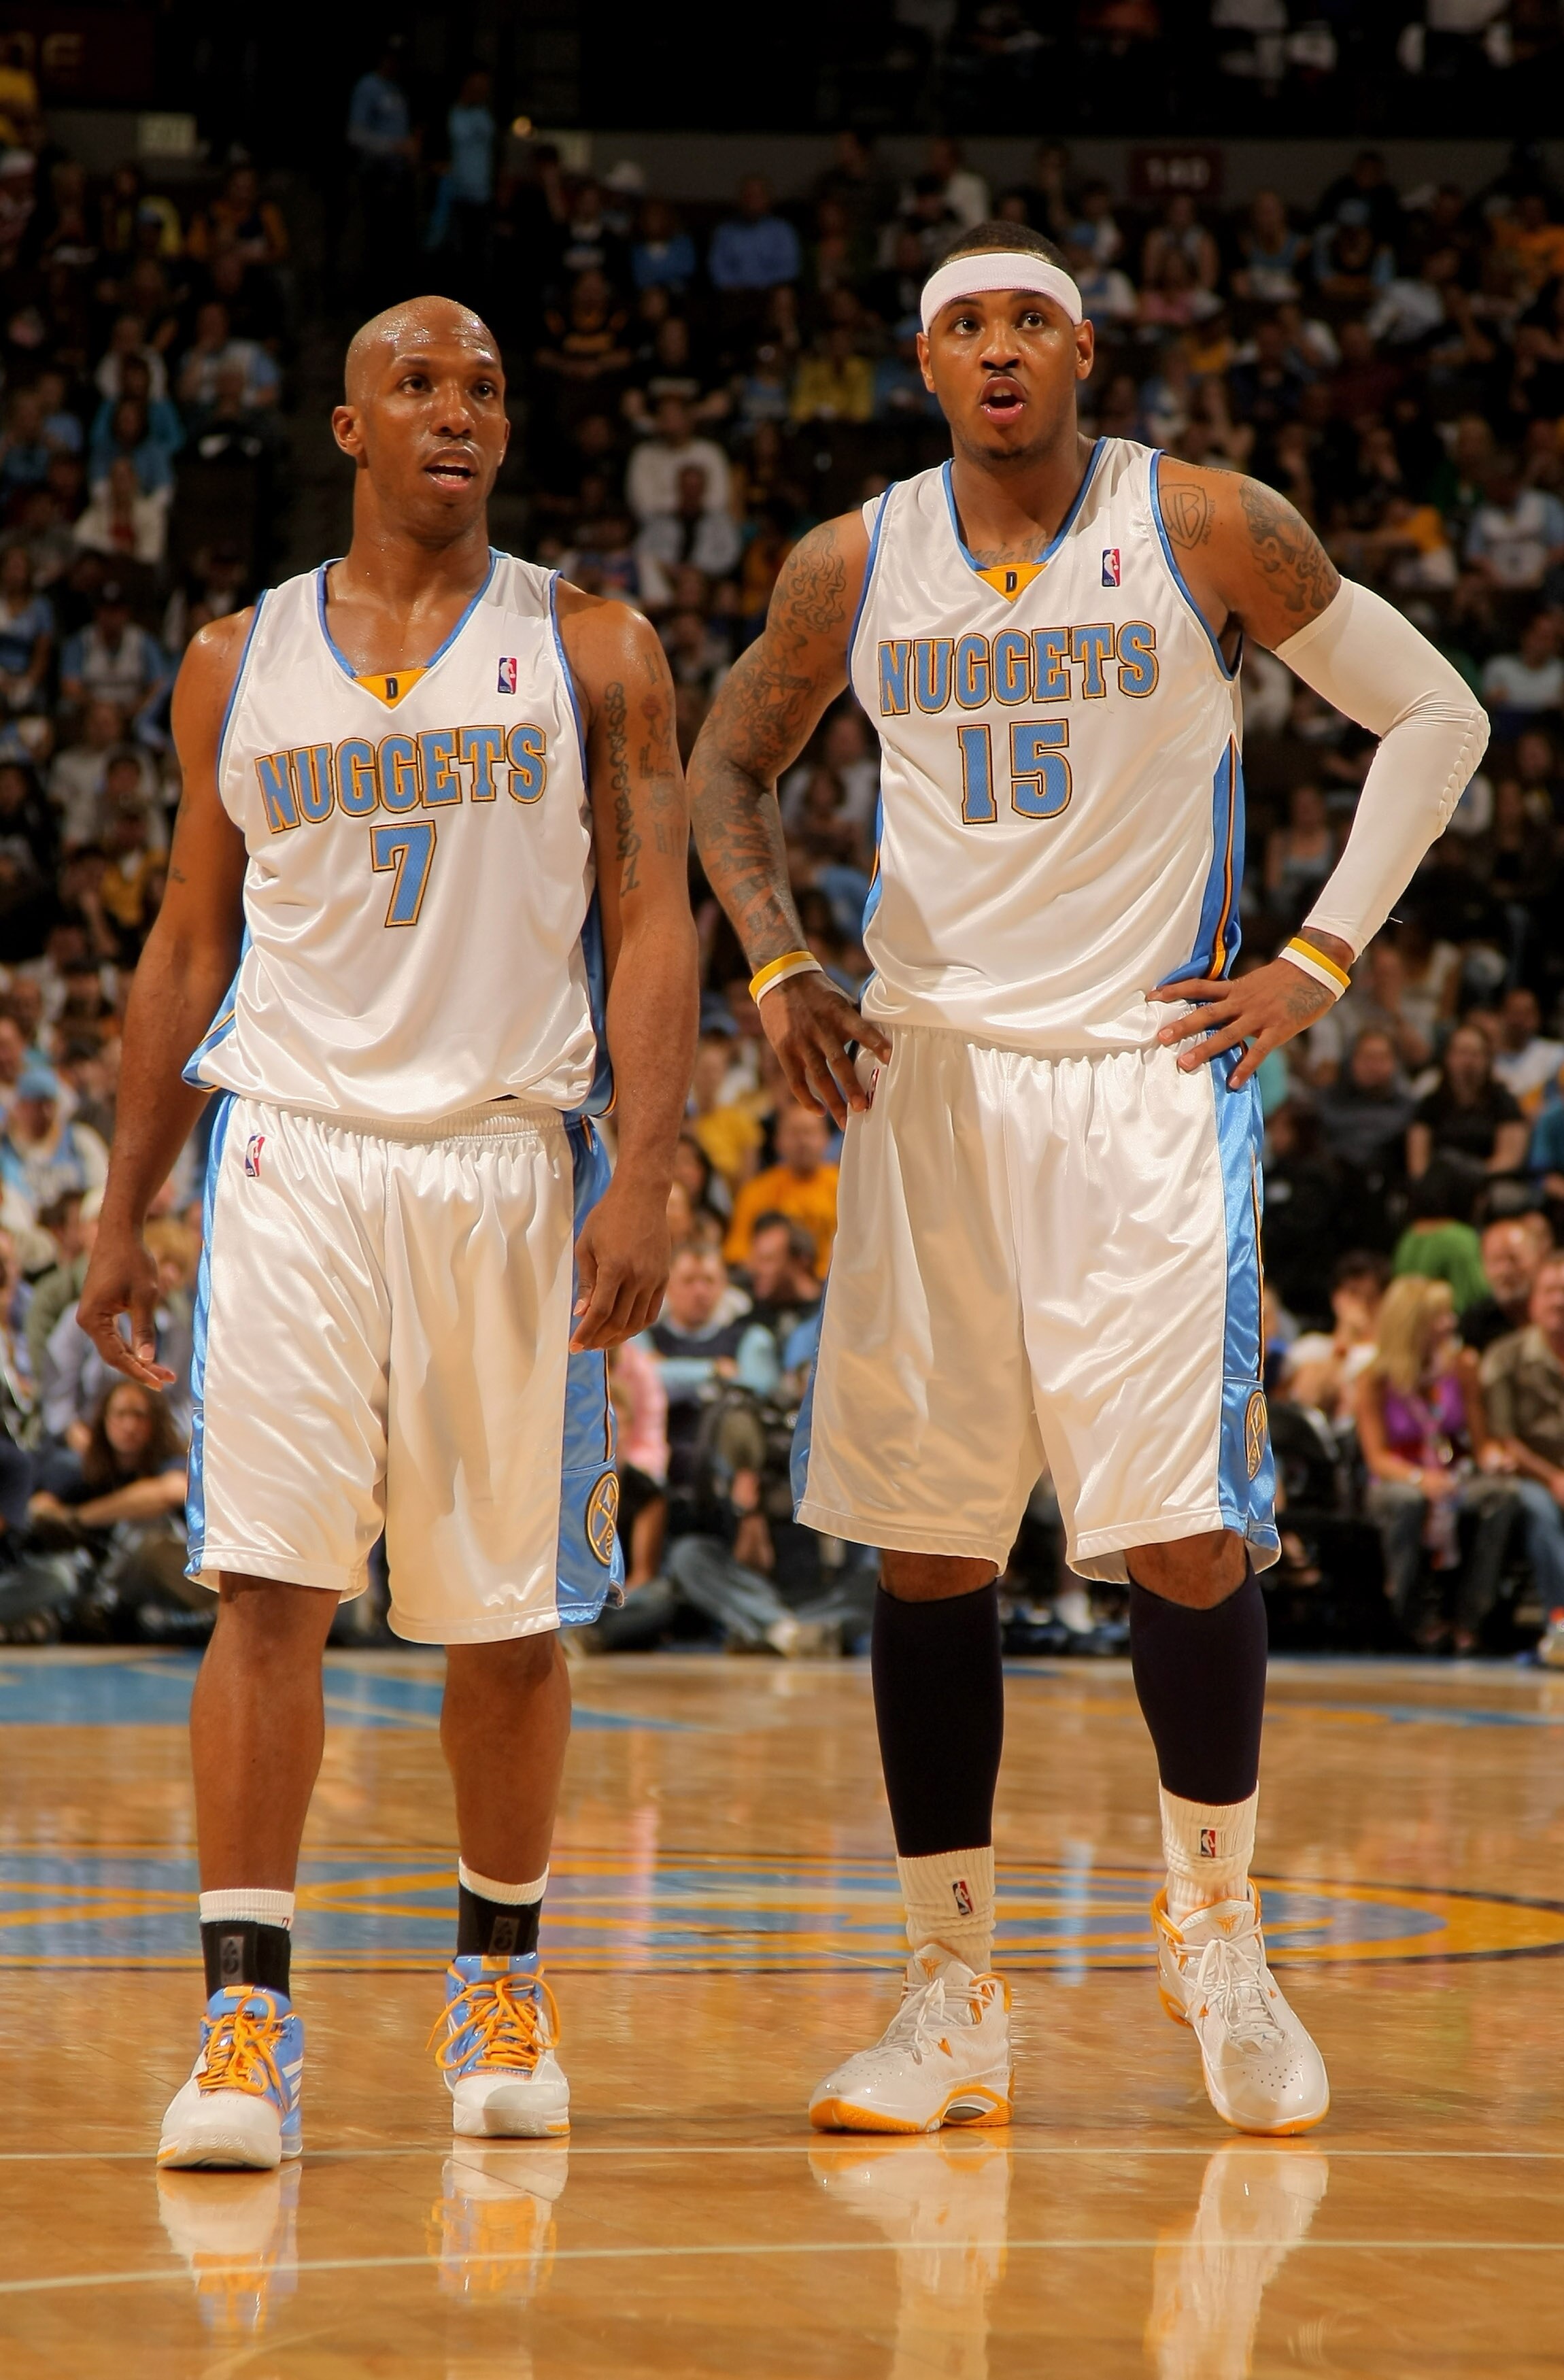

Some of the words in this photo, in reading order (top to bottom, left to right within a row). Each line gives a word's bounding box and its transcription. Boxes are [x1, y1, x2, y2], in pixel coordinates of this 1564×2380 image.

[1006, 571, 1017, 593] D
[386, 677, 398, 700] D
[879, 620, 1159, 717] NUGGETS
[255, 722, 547, 834] NUGGETS
[957, 718, 1072, 825] 15
[369, 819, 437, 928] 7
